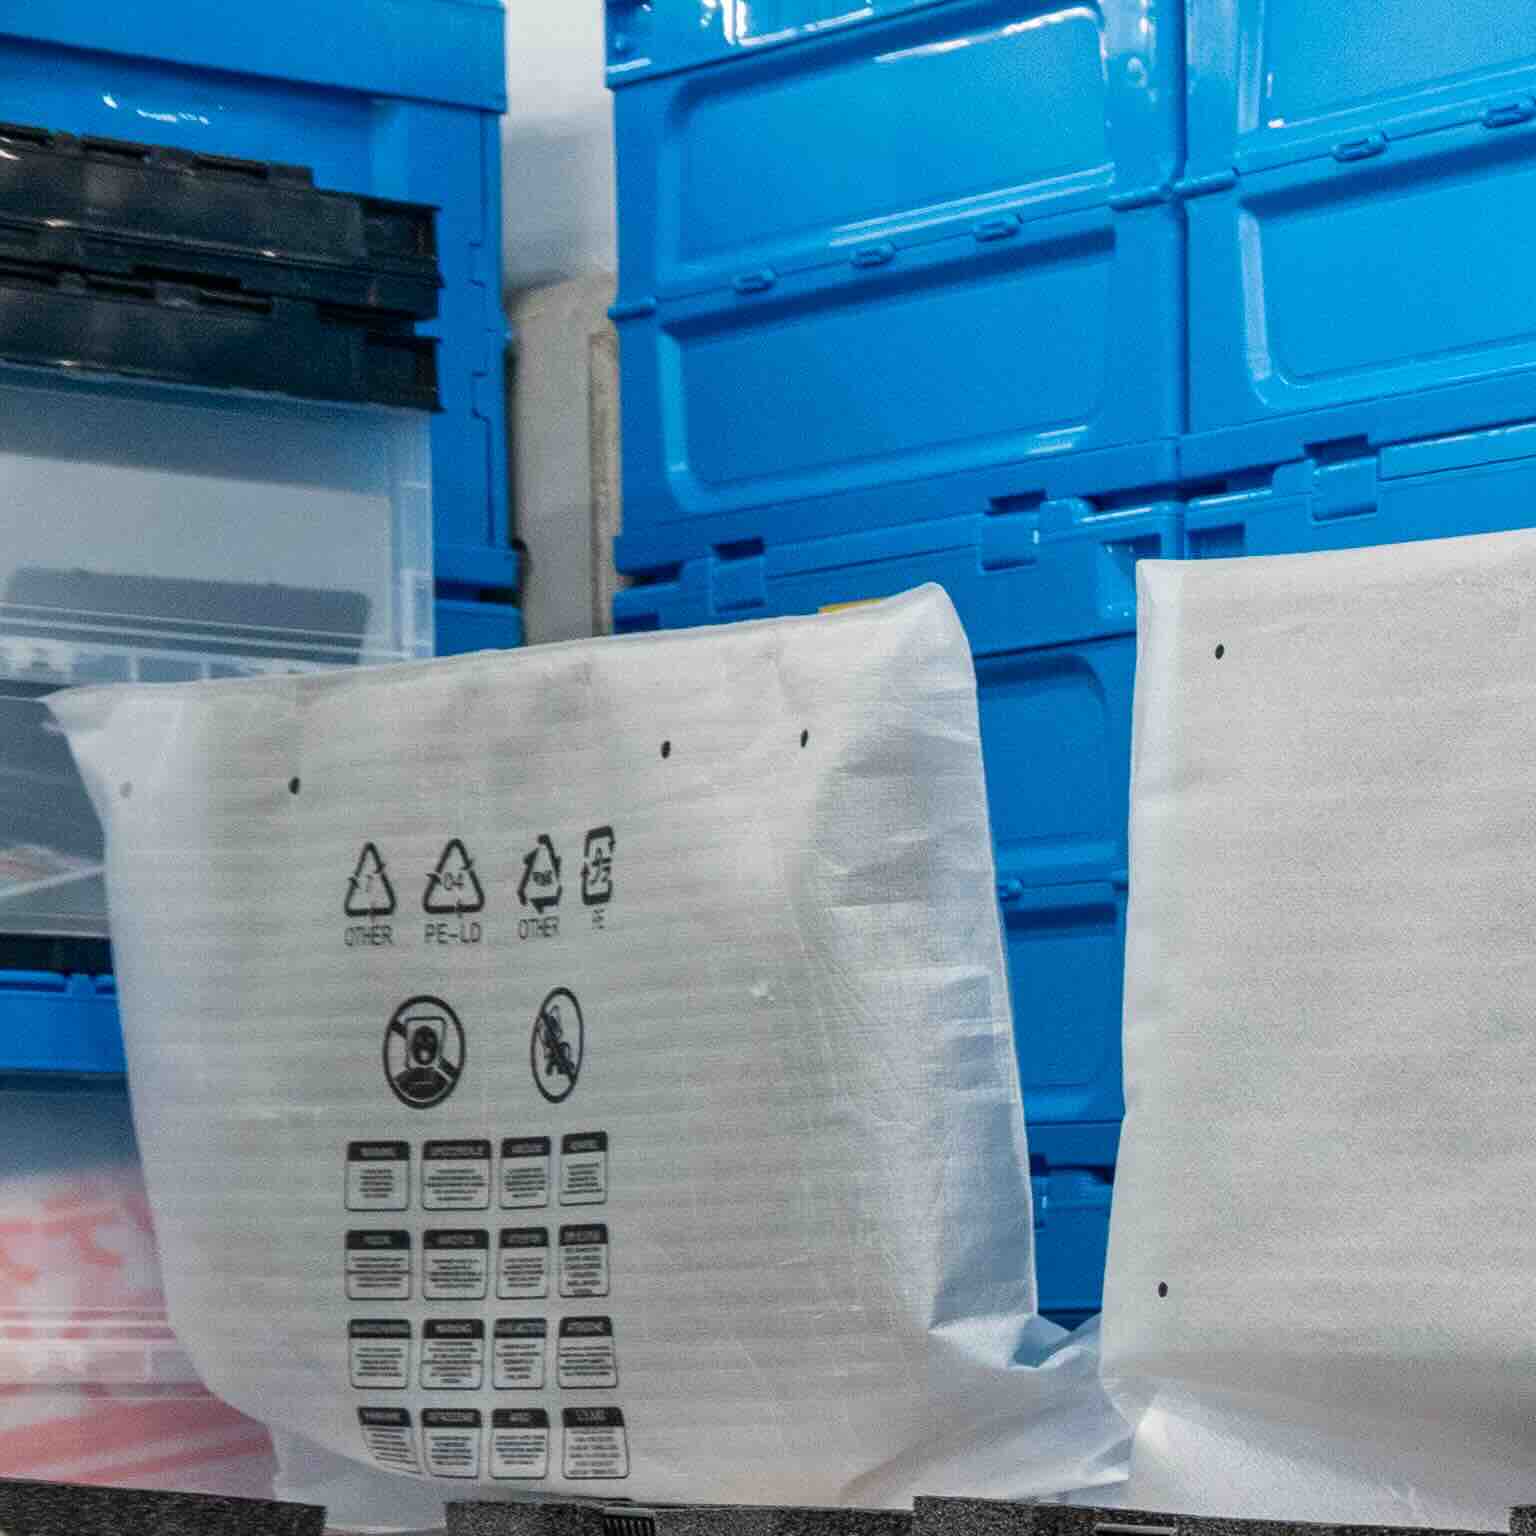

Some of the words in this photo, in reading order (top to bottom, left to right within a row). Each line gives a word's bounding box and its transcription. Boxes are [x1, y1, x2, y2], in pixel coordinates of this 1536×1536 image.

[344, 924, 393, 947] OTHER
[425, 921, 481, 945] PE-LD
[518, 915, 560, 939] OTHER
